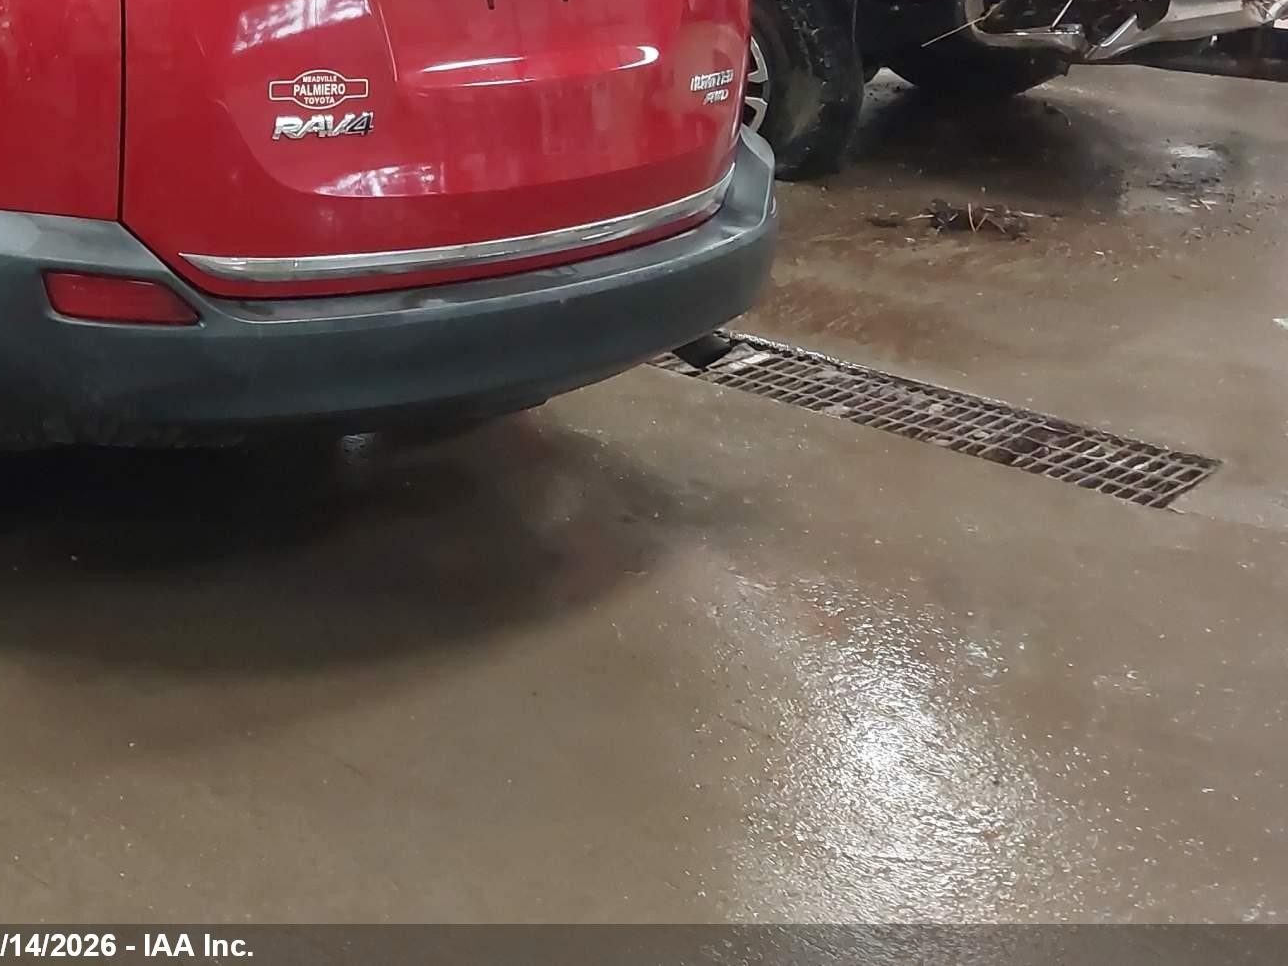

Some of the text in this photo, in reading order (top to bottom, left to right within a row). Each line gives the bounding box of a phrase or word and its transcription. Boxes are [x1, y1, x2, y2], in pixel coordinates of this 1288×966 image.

[302, 75, 337, 83] MEADVILLE
[293, 83, 346, 96] PALMIERO
[303, 96, 335, 105] TOYOTA
[272, 111, 374, 140] RAV4
